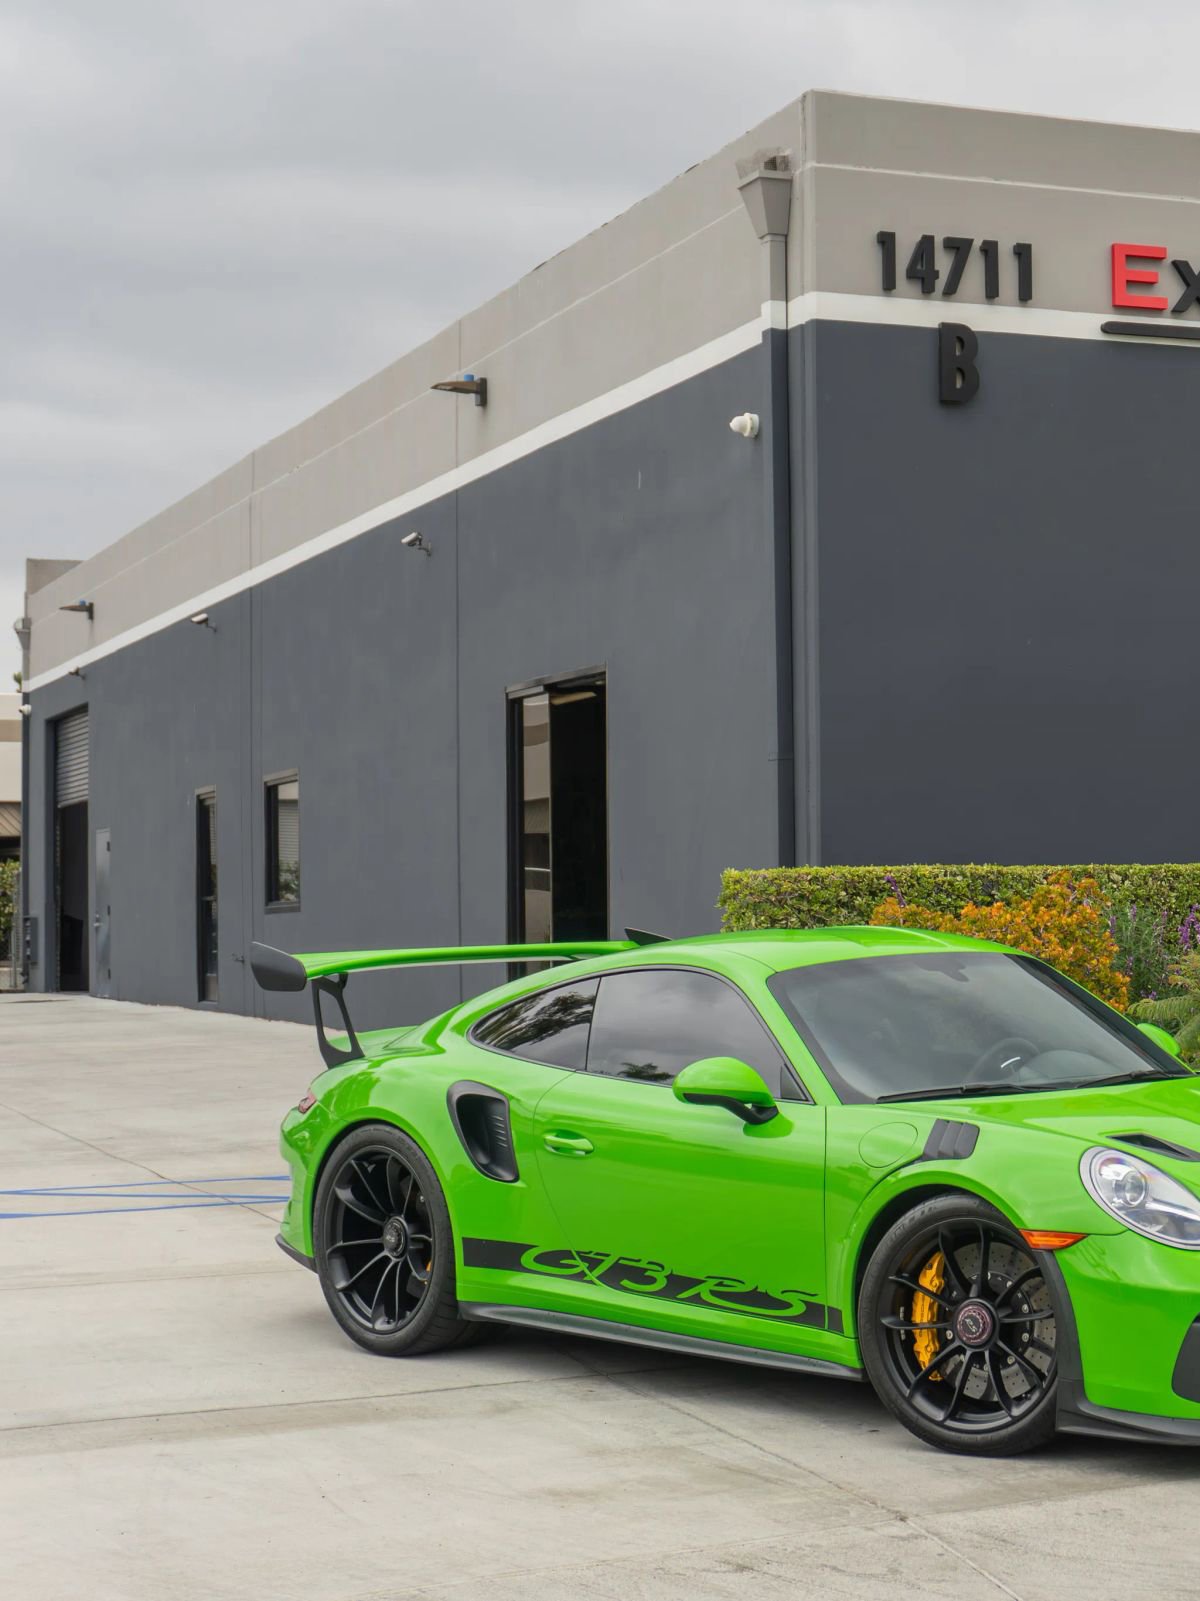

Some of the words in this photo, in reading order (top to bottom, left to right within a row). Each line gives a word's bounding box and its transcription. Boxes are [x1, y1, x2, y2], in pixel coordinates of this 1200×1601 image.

[876, 230, 1033, 301] 14711
[938, 321, 980, 404] B
[520, 1244, 674, 1293] GT3
[675, 1274, 821, 1317] RS
